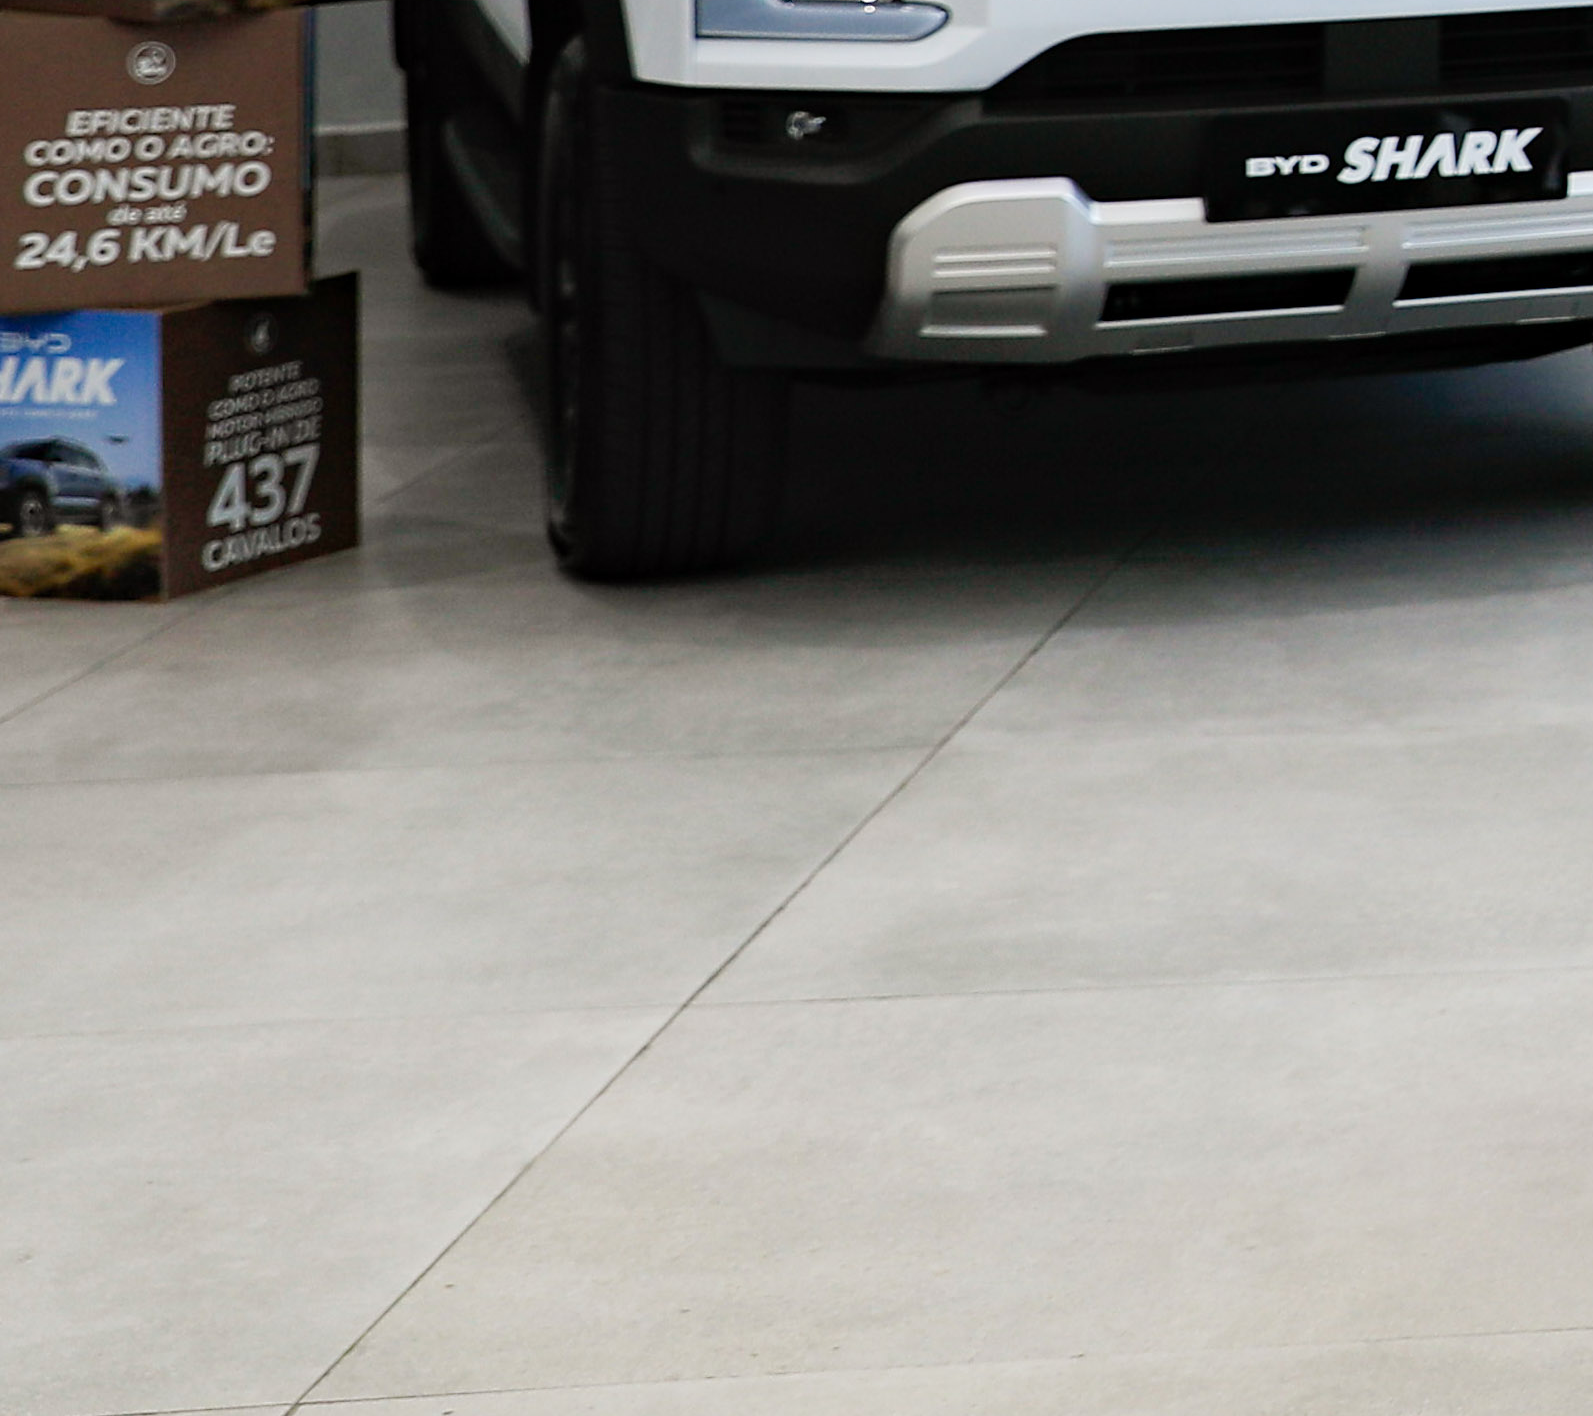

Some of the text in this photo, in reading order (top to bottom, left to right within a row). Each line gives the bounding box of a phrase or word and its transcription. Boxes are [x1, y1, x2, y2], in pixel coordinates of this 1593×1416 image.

[65, 103, 236, 137] EFICIENTE
[24, 130, 275, 167] COMO O AGRO:
[1245, 127, 1544, 184] BYD SHARK
[23, 161, 272, 207] CONSUMO
[106, 202, 188, 226] de até
[14, 221, 277, 273] 24,6 KM/Le
[0, 356, 126, 406] ARK
[207, 443, 320, 532] 437
[202, 513, 322, 573] CAVALOS
